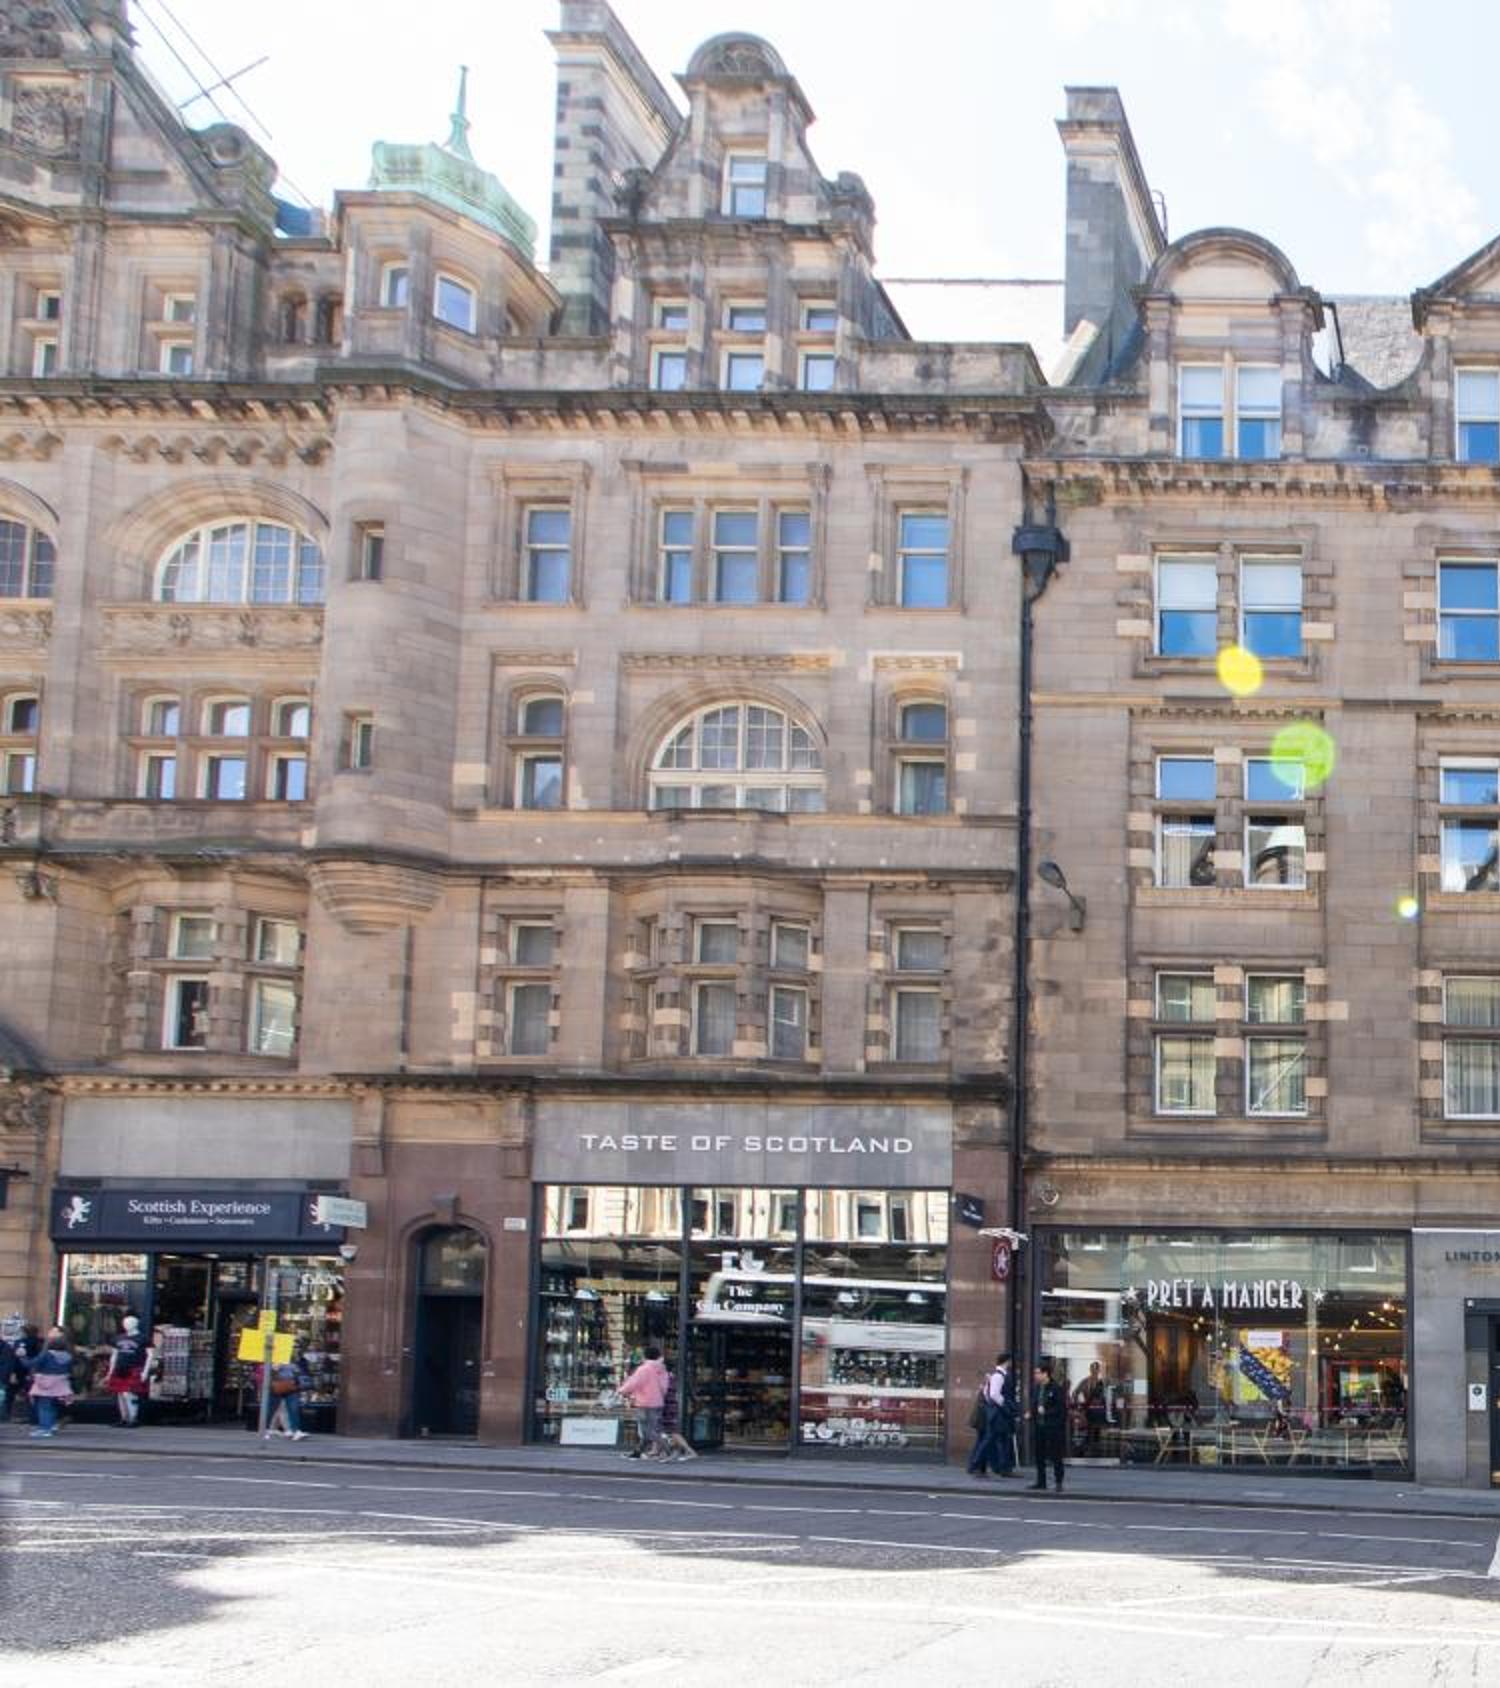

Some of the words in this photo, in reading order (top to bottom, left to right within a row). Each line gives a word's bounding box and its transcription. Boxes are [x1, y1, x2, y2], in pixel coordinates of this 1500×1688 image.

[581, 1135, 677, 1151] TASTE
[691, 1135, 733, 1151] OF
[744, 1135, 913, 1154] SCOTLAND
[127, 1199, 186, 1214] Scottish
[190, 1200, 271, 1217] Experience
[726, 1285, 753, 1297] The
[1147, 1279, 1196, 1307] PRET
[1201, 1281, 1214, 1308] A
[1222, 1279, 1304, 1309] MANGER
[723, 1300, 784, 1315] Company
